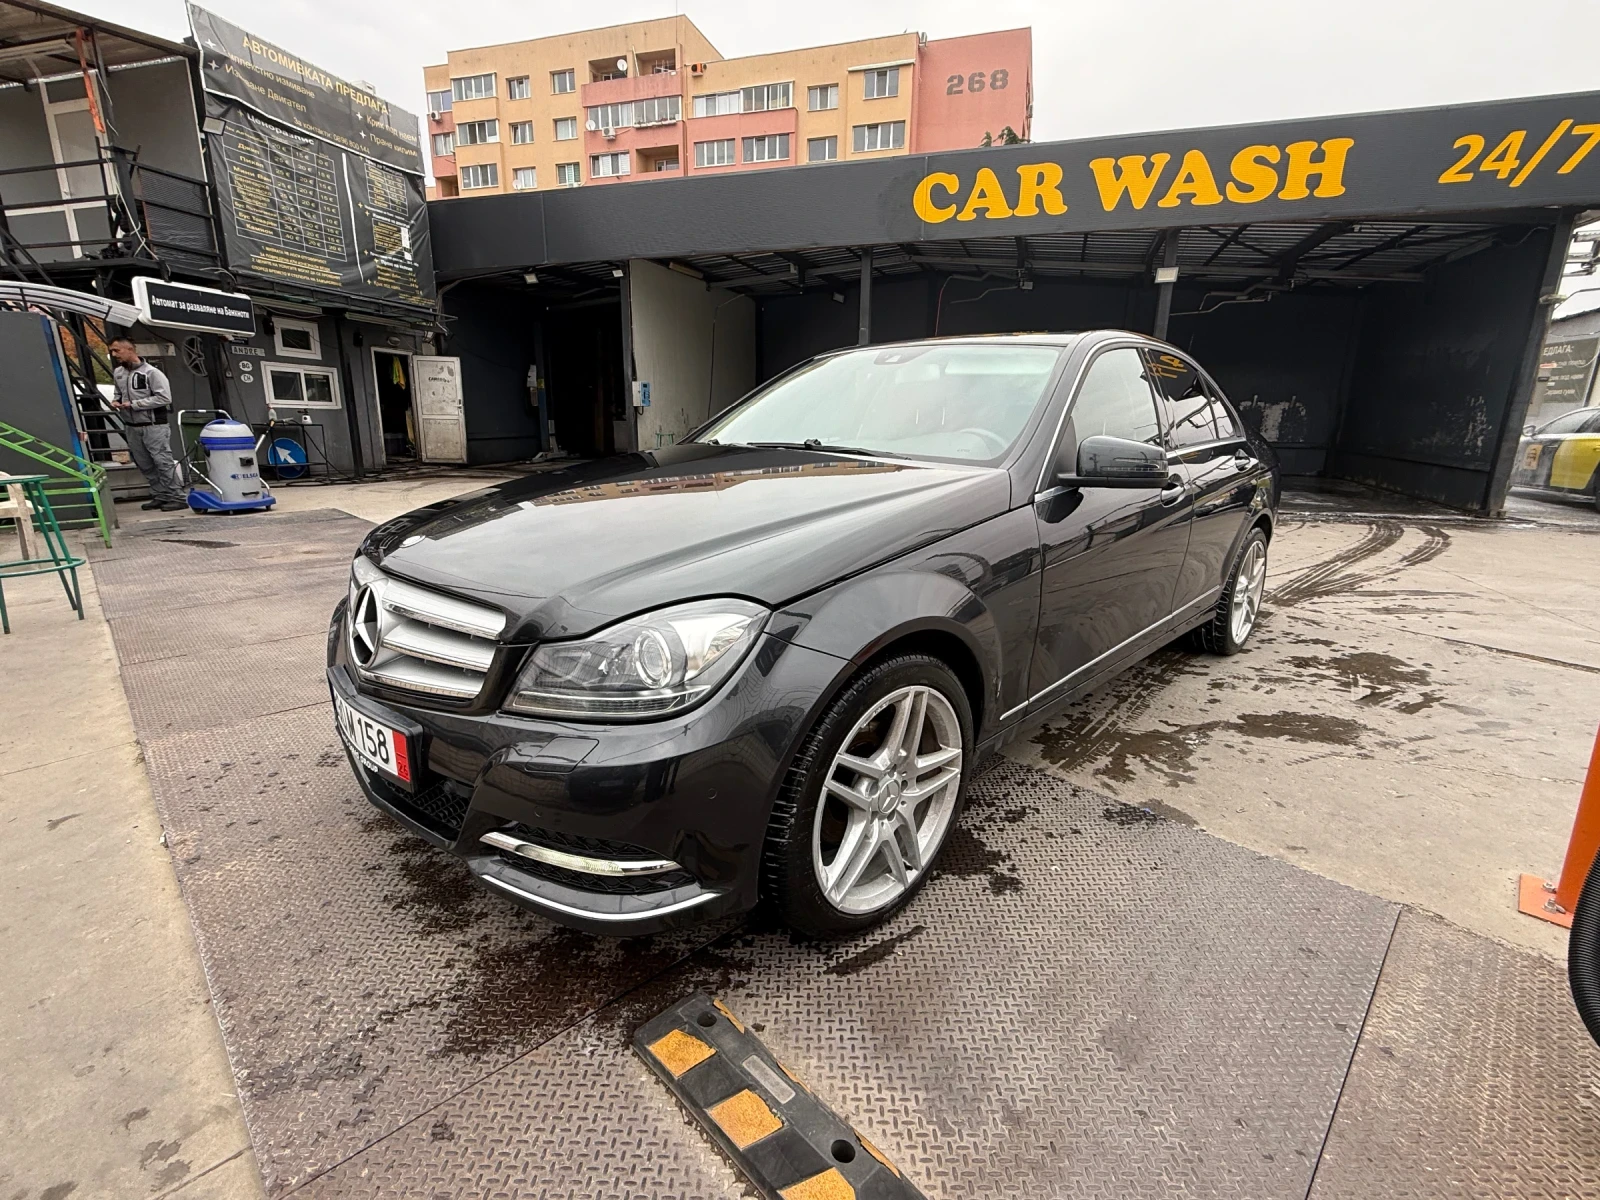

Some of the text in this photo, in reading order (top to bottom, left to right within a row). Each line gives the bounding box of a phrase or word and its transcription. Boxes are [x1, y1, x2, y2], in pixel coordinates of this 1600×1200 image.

[242, 36, 391, 117] АВТОМИВКАТА ПРЕДЛАГА:
[275, 75, 315, 99] измиване
[946, 70, 1009, 95] 268
[267, 88, 307, 112] Двигател
[246, 113, 315, 145] Ценоразпис
[913, 119, 1600, 223] CAR WASH 24/7
[151, 294, 250, 319] Автомат за разваляне на Банкноти
[1543, 344, 1574, 356] ЕДЛАГА:
